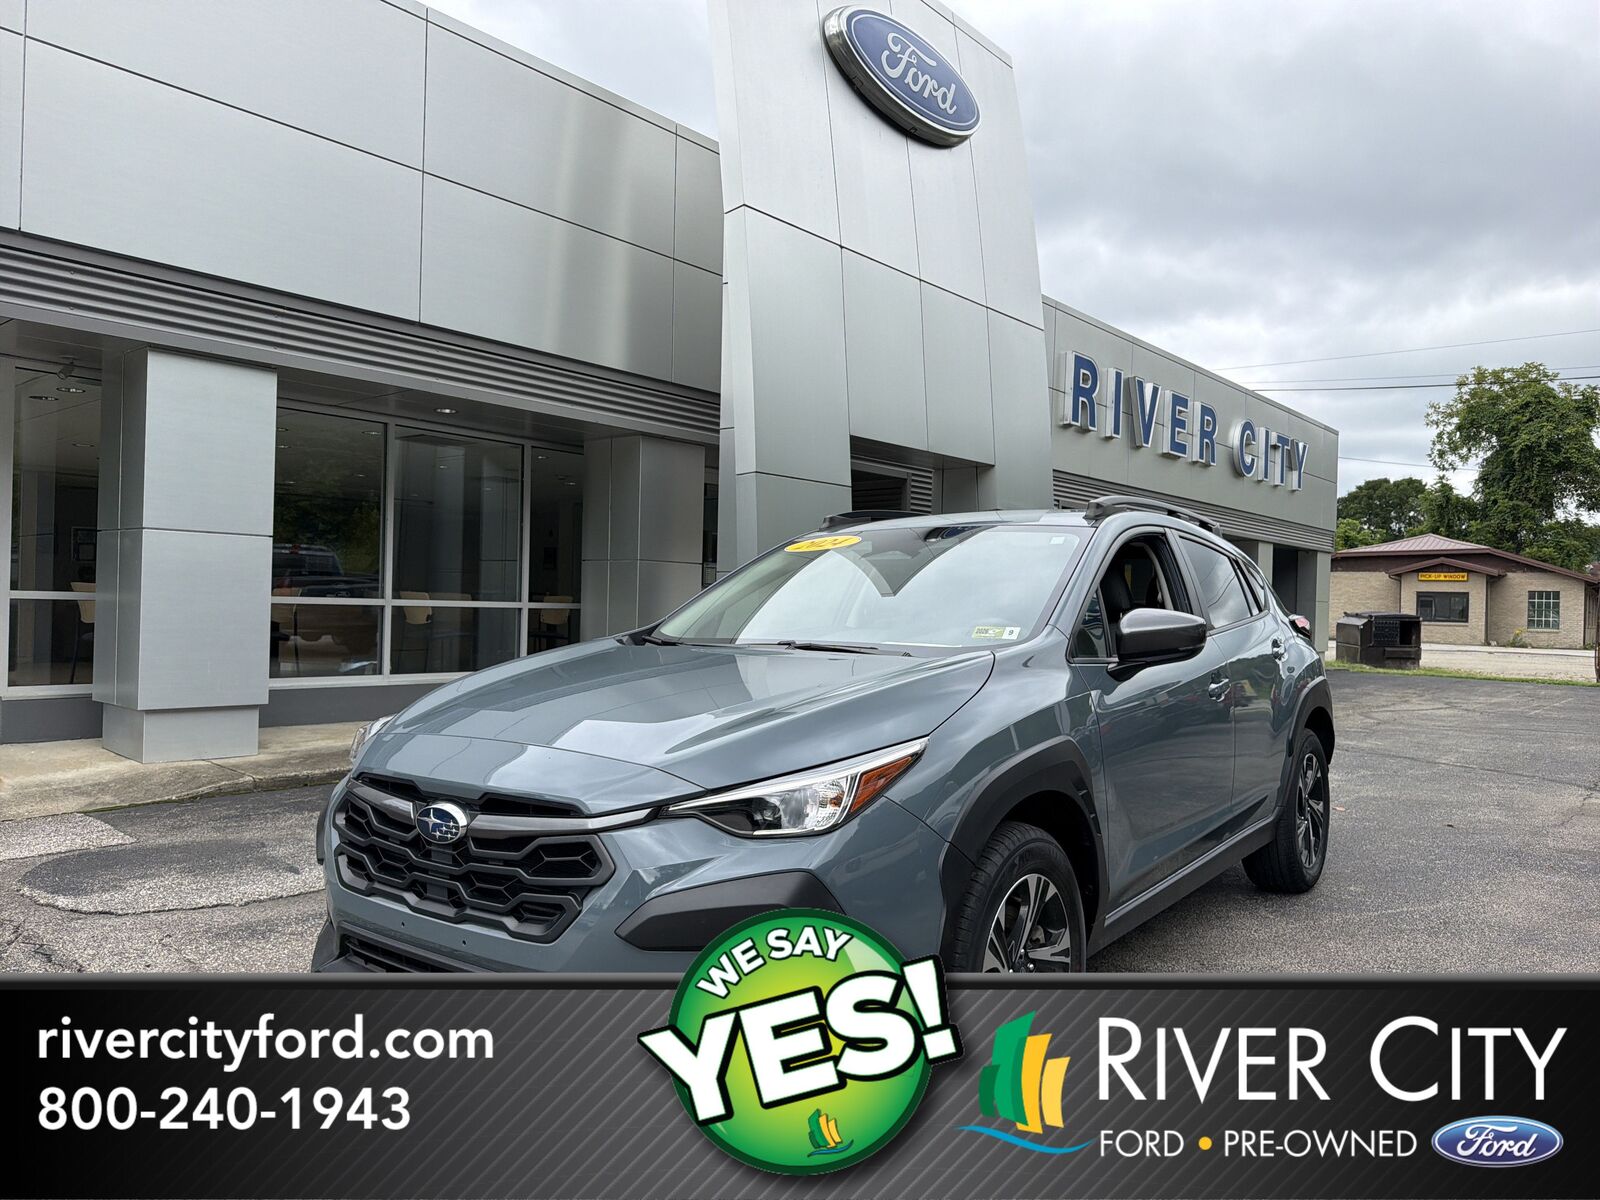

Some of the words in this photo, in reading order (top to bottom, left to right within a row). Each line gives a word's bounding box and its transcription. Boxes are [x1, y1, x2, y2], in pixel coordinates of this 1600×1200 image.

[881, 32, 957, 115] Ford
[1063, 351, 1218, 467] RIVER
[1232, 418, 1309, 492] CITY
